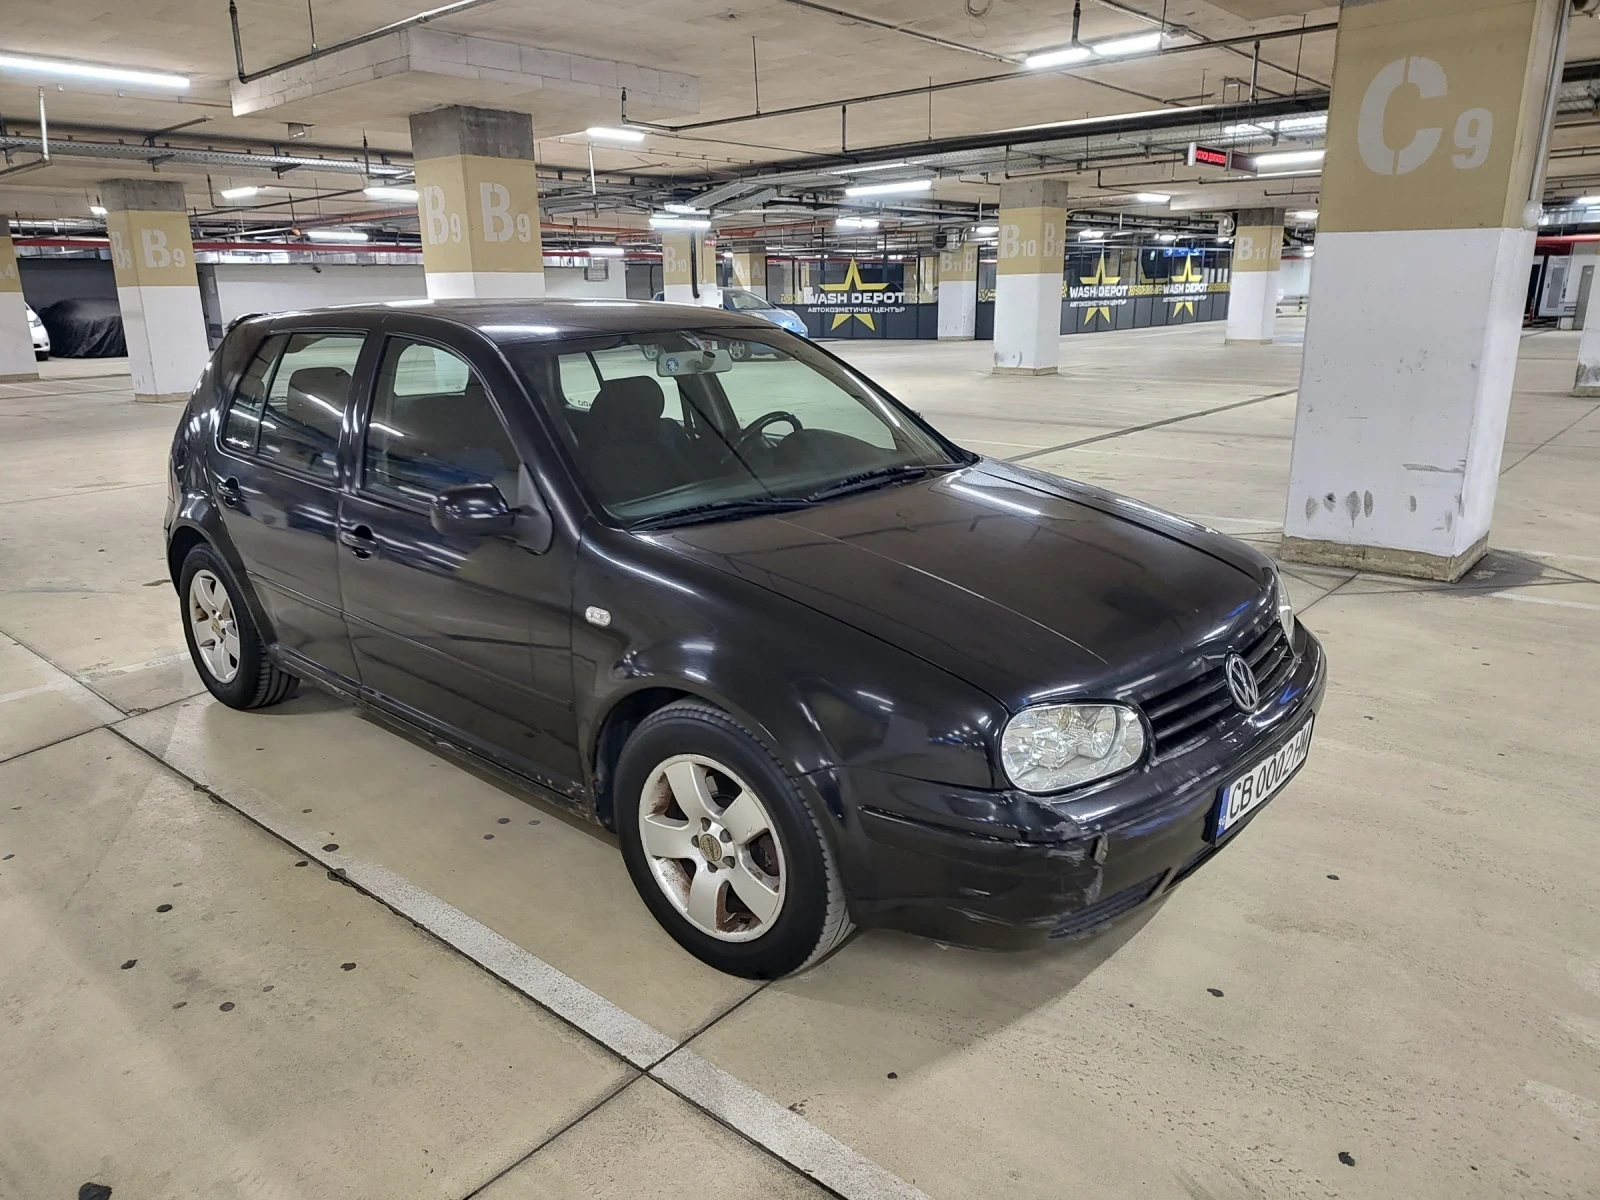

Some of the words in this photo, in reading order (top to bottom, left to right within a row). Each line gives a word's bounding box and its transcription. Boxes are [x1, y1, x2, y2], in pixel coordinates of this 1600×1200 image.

[1358, 56, 1494, 175] C9
[424, 185, 462, 245] B9
[480, 182, 531, 243] B9
[112, 231, 132, 269] B9
[141, 229, 186, 268] B9
[1001, 224, 1037, 258] B10
[1237, 236, 1267, 260] B11
[808, 292, 848, 304] WASH
[851, 292, 906, 304] DEPOT
[1069, 285, 1097, 299] WASH
[1098, 285, 1129, 297] DEPOT
[1163, 284, 1184, 295] WASH
[1185, 282, 1209, 294] DEPOT
[807, 306, 873, 314] АВТОКОЗМЕТИЧЕН
[874, 306, 906, 314] ЦЕНТЪР
